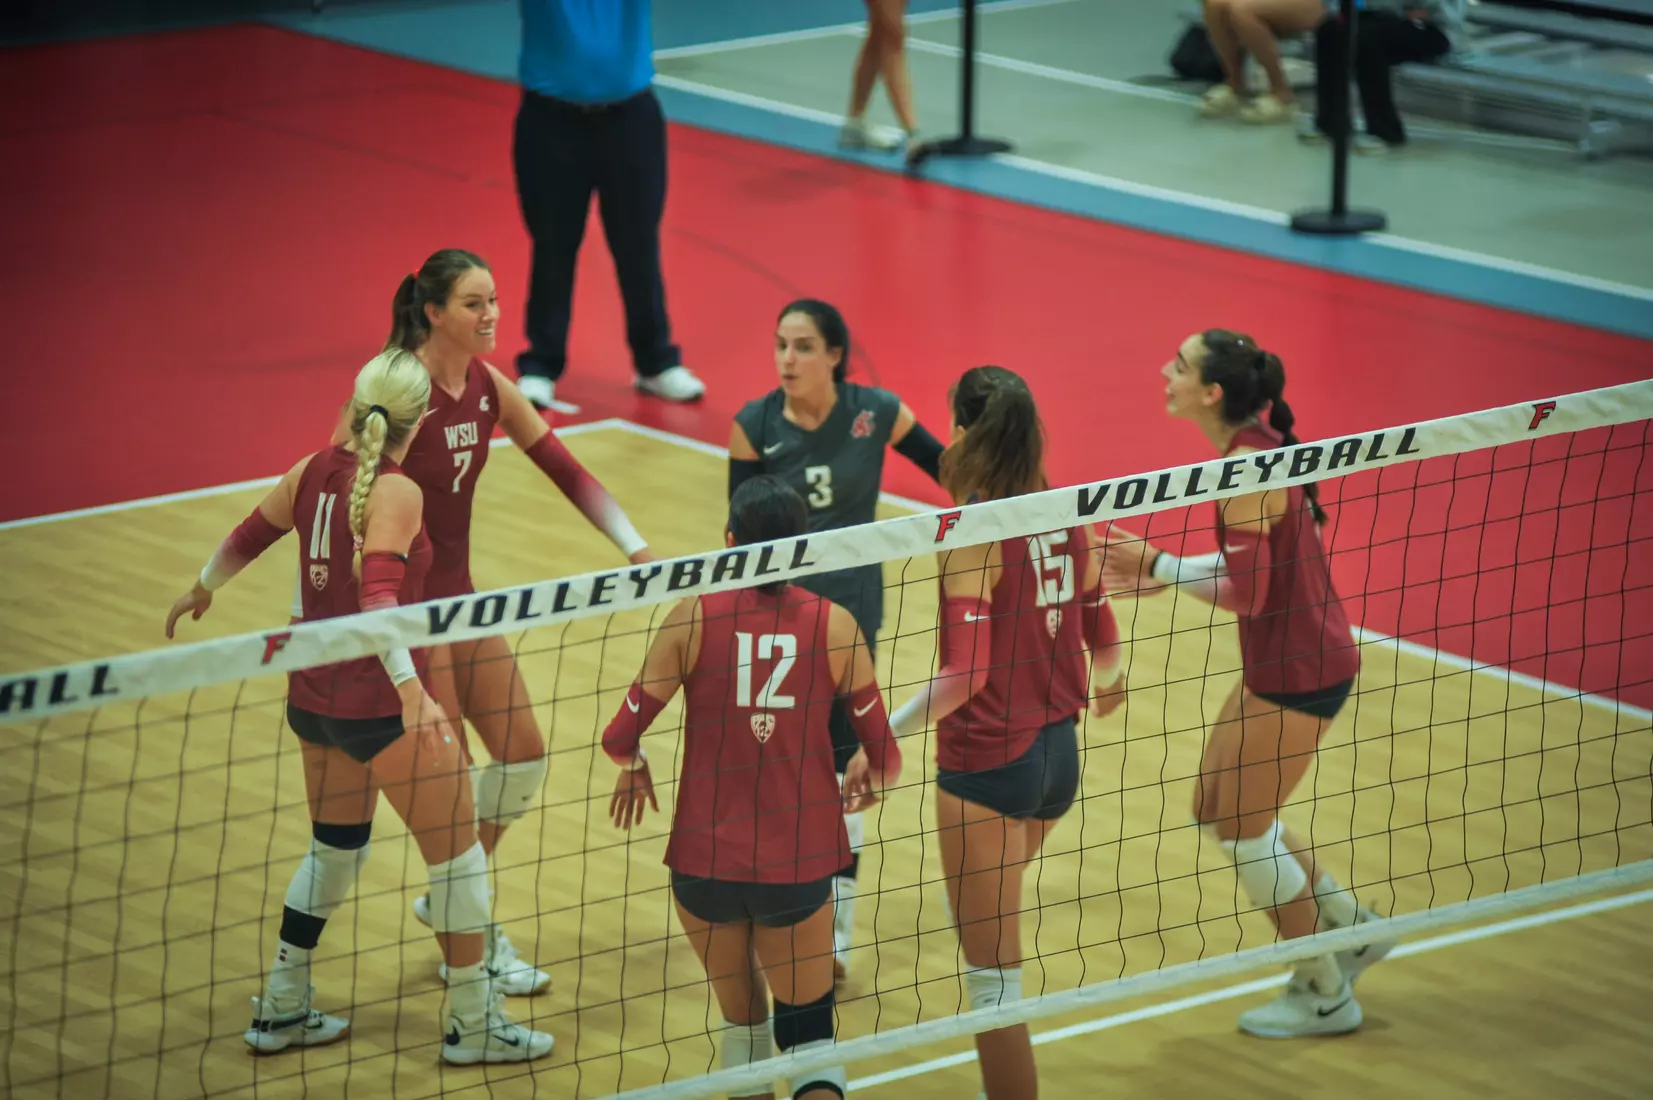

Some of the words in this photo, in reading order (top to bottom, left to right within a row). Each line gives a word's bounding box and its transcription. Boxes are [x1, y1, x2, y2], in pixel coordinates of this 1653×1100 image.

[444, 421, 478, 449] WSU
[452, 450, 472, 493] 7
[805, 465, 833, 508] 3
[1076, 427, 1420, 518] VOLLEYBALL
[309, 492, 337, 559] 11
[427, 538, 816, 635] VOLLEYBALL
[1026, 529, 1075, 607] 15
[735, 631, 797, 709] 12
